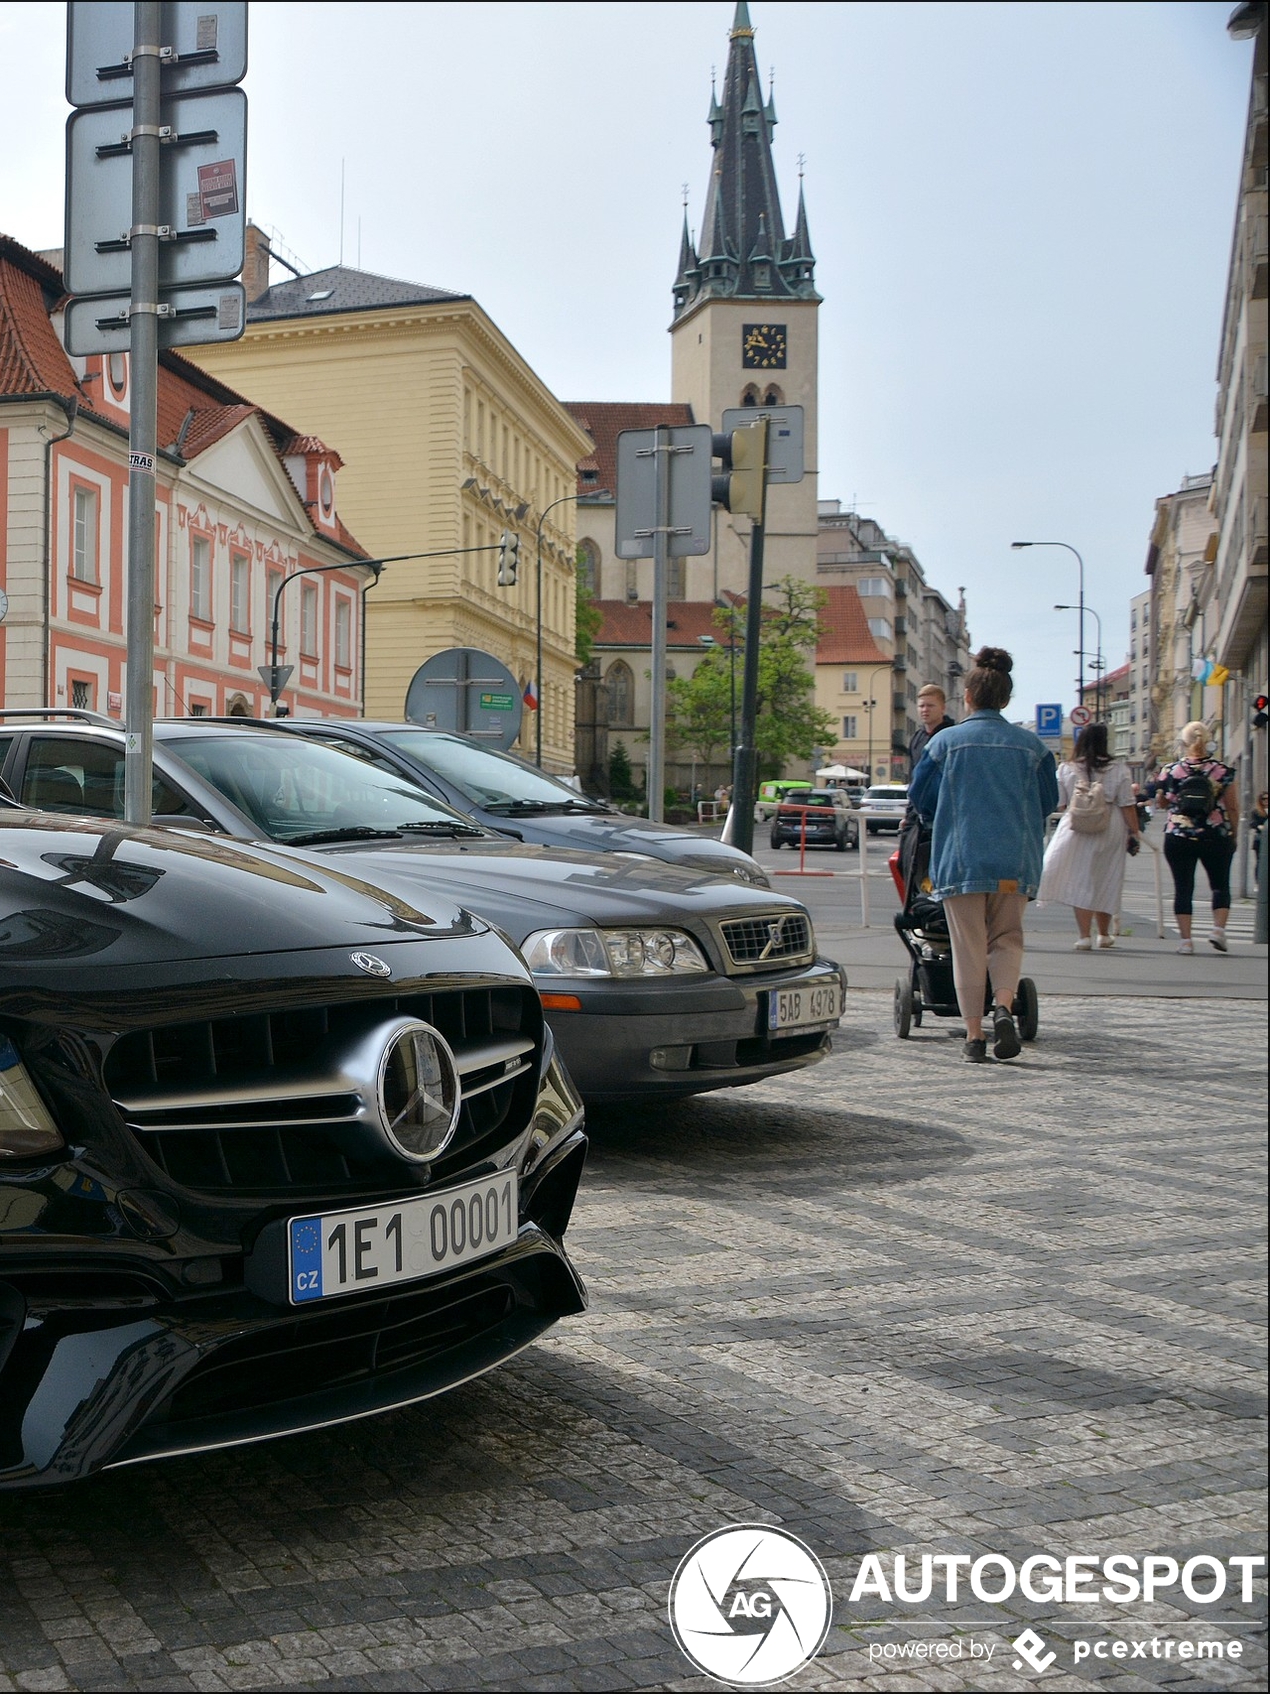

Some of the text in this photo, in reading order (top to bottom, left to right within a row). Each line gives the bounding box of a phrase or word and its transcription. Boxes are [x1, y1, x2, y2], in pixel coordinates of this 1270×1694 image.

[1040, 708, 1057, 727] P
[810, 989, 835, 1018] 4978
[327, 1180, 512, 1284] 1E1 00001
[296, 1269, 319, 1291] CZ
